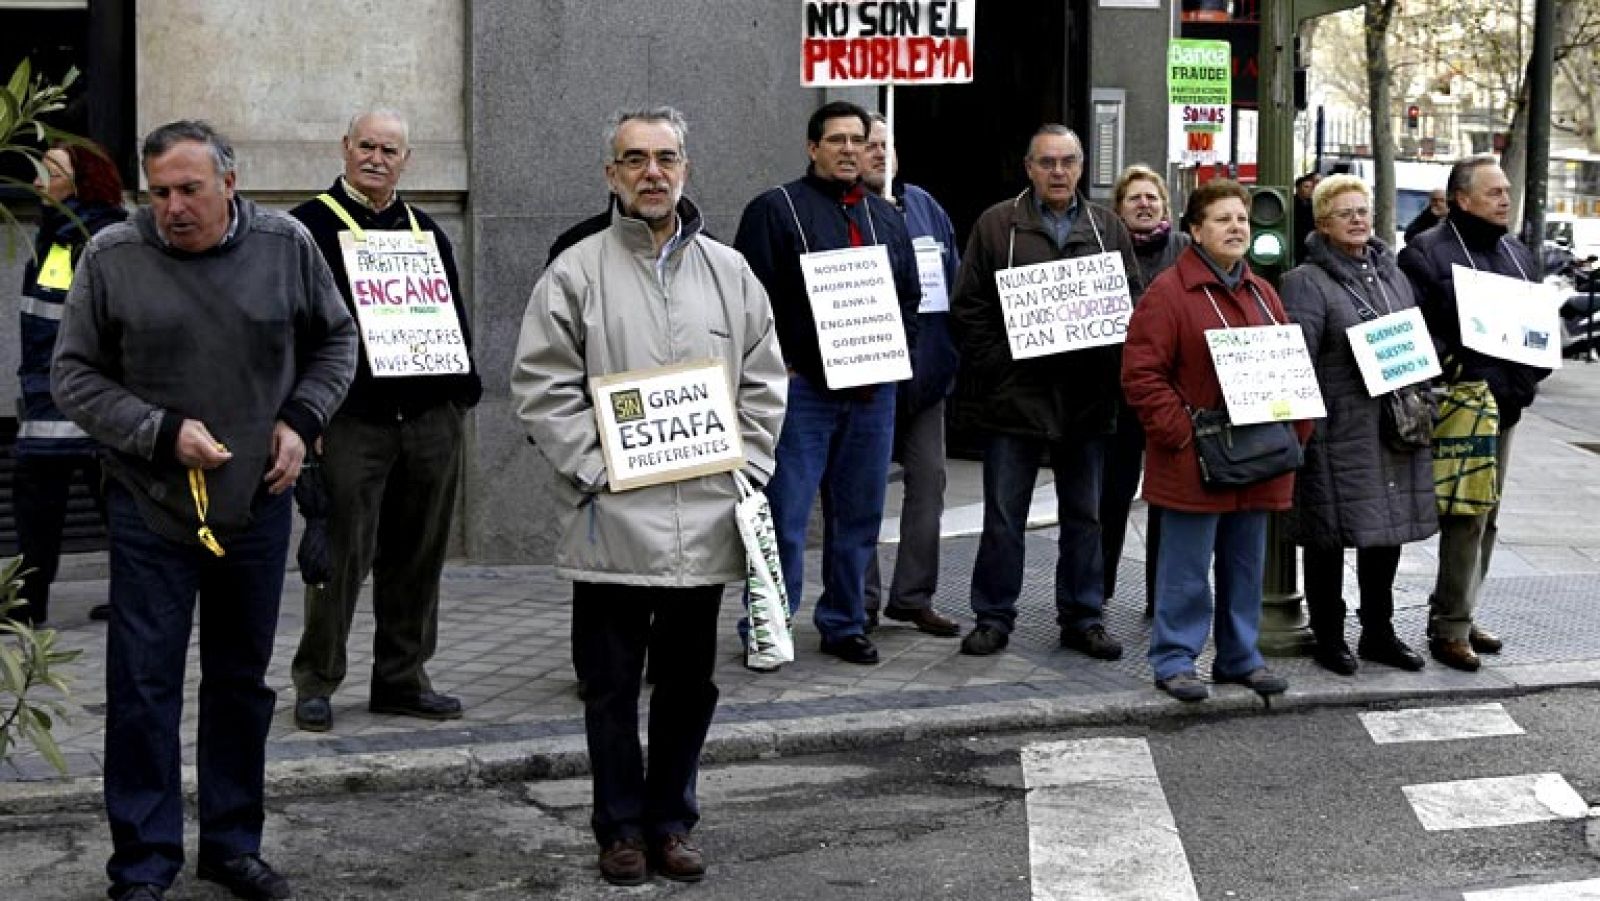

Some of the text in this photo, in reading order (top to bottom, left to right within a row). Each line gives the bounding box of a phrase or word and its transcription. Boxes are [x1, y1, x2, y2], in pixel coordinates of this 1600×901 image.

[806, 1, 968, 36] NO SON EL
[804, 37, 971, 82] PROBLEMA
[814, 259, 878, 275] NOSOTROS
[999, 269, 1048, 290] NUNCA
[1052, 264, 1072, 282] UN
[832, 295, 878, 310] BANKIA
[1004, 275, 1126, 309] TAN POBRE HIZO
[1008, 294, 1130, 329] A UNOS CHORIZOS
[832, 333, 893, 349] GOBIERNO
[1011, 315, 1127, 350] TAN RICOS
[826, 349, 905, 368] ENCUBRIENDO
[616, 383, 709, 418] SIN GRAN
[619, 409, 725, 450] ESTAFA
[628, 438, 730, 468] PREFERENTES
